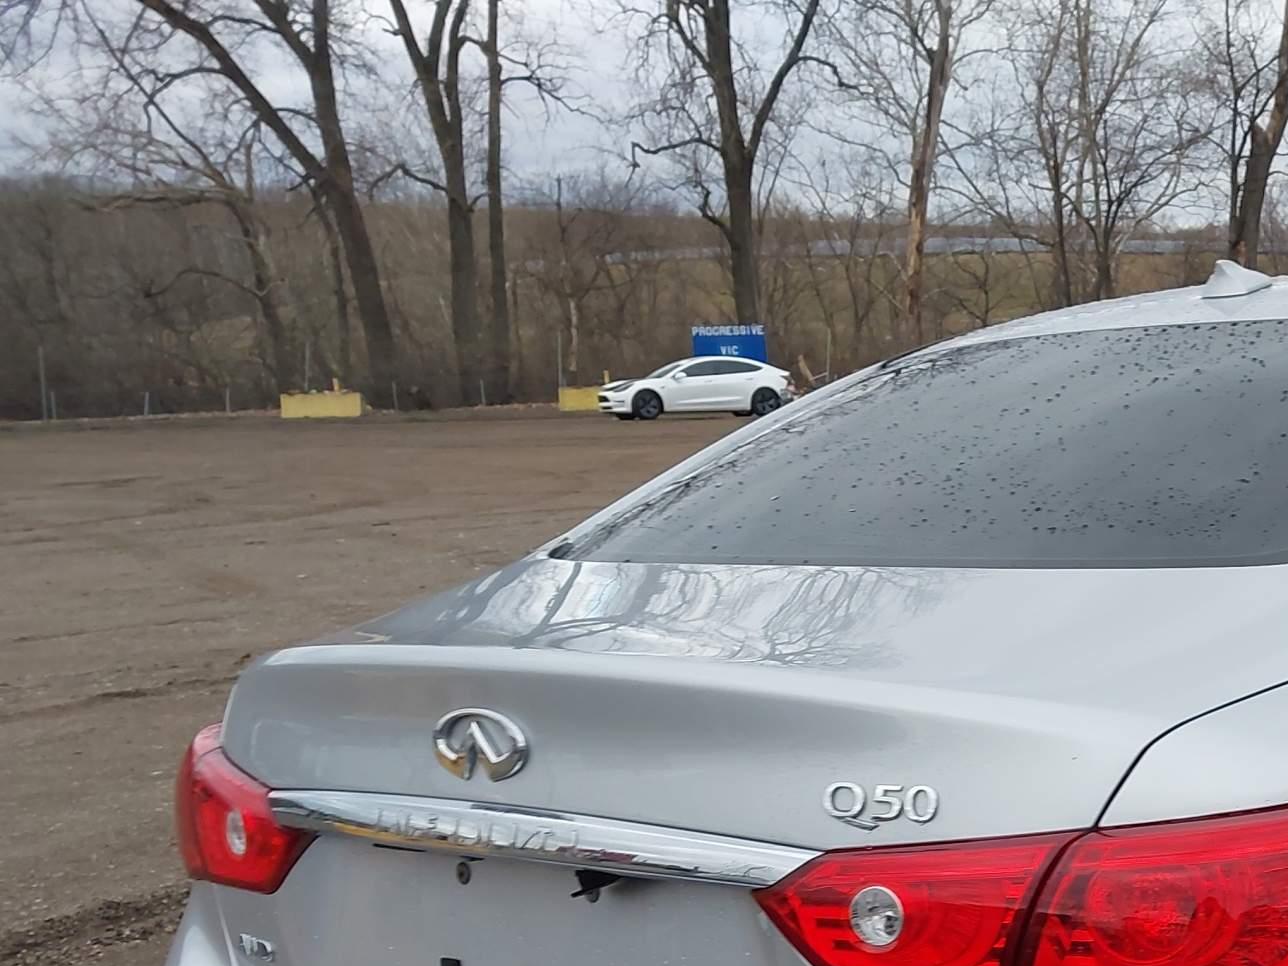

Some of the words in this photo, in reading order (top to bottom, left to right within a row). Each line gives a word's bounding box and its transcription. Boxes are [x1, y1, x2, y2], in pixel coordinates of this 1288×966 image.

[691, 325, 765, 336] PROGRESSIVE
[719, 345, 740, 355] VIC
[822, 781, 939, 832] Q50
